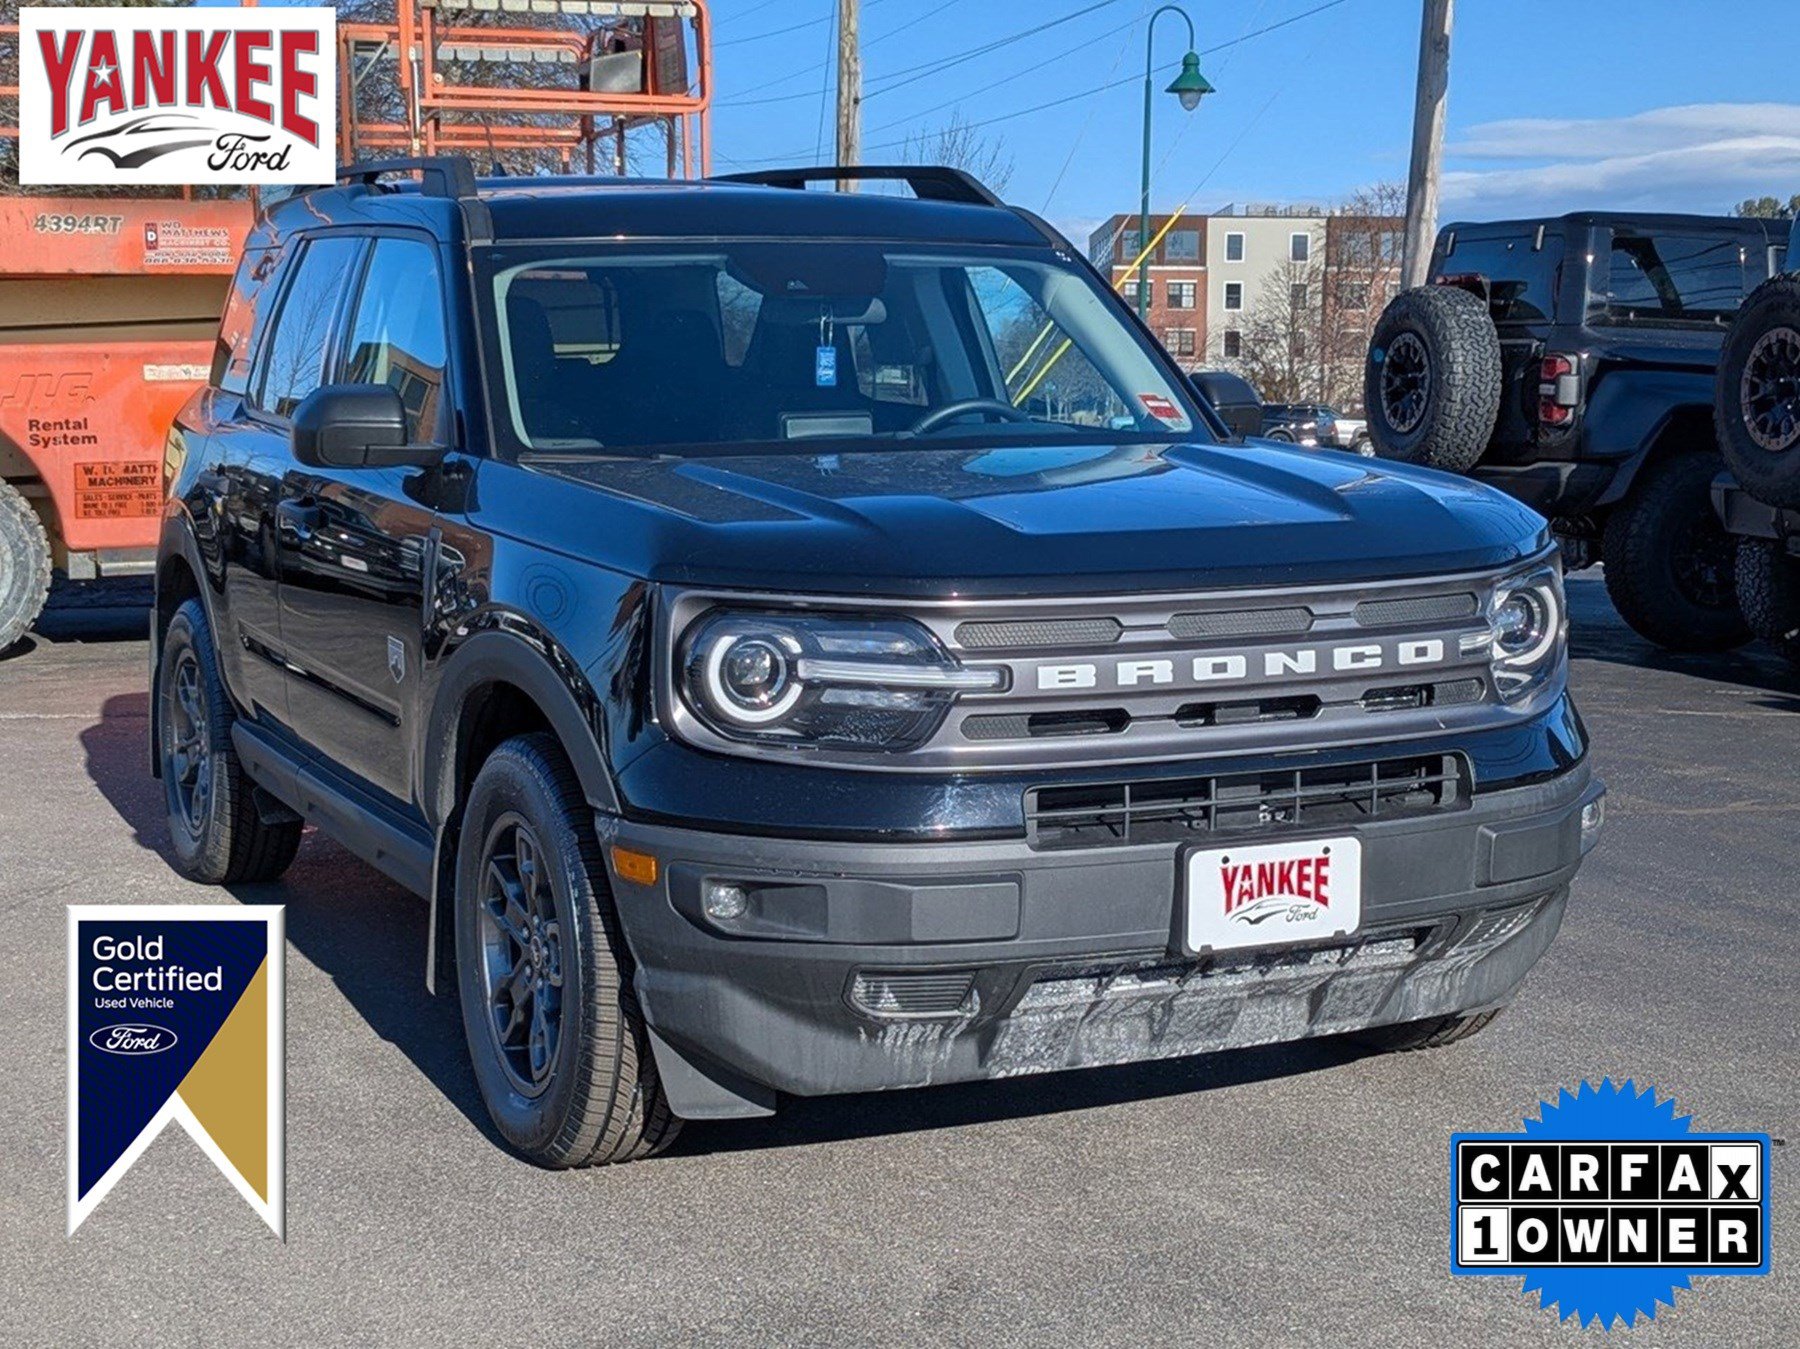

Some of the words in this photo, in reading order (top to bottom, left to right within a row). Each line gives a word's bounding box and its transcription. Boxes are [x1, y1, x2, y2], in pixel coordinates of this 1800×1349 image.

[34, 214, 123, 234] 4394RT
[28, 417, 88, 432] Rental
[29, 433, 98, 449] System
[88, 476, 156, 487] MACHINERY
[1037, 638, 1444, 690] BRONCO
[1220, 856, 1331, 916] YANKEE
[1285, 904, 1319, 923] Ford
